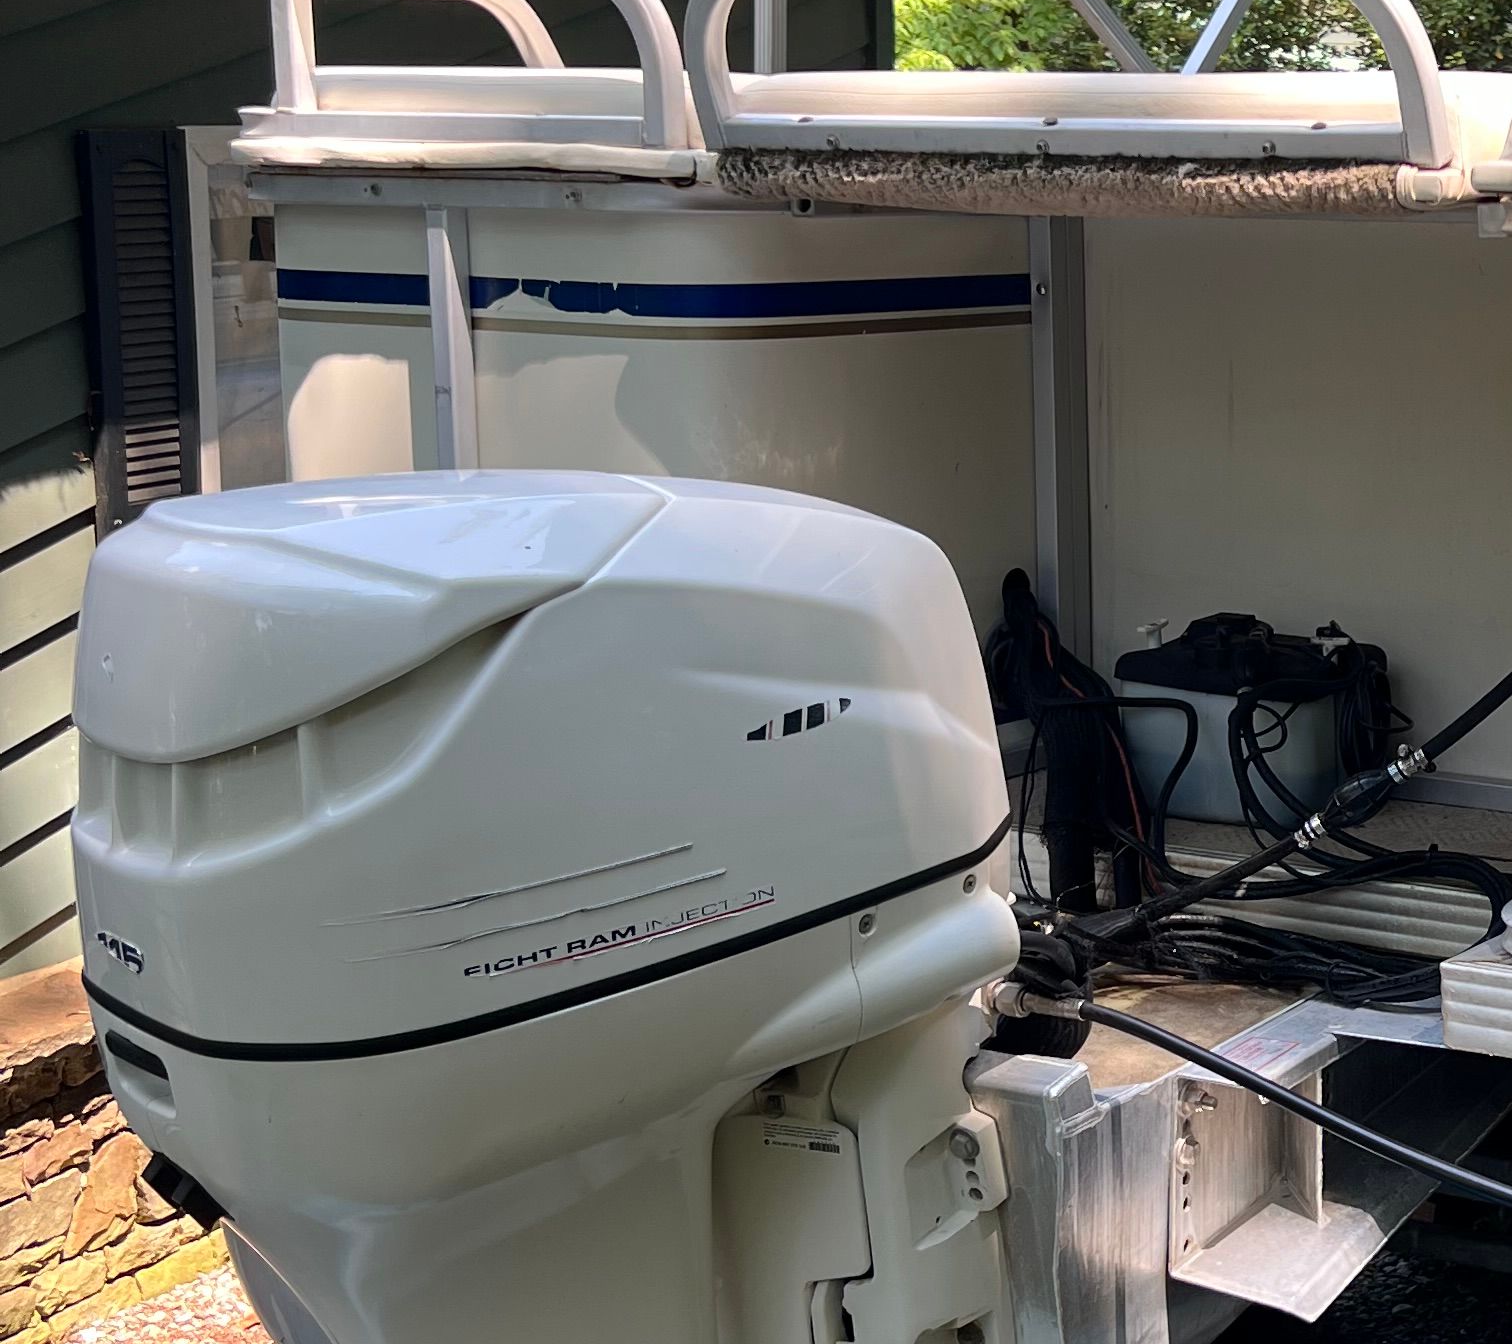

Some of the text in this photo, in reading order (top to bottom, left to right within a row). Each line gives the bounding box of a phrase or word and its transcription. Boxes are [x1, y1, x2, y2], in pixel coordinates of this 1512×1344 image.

[463, 886, 775, 977] FICHT RAM INJECTON
